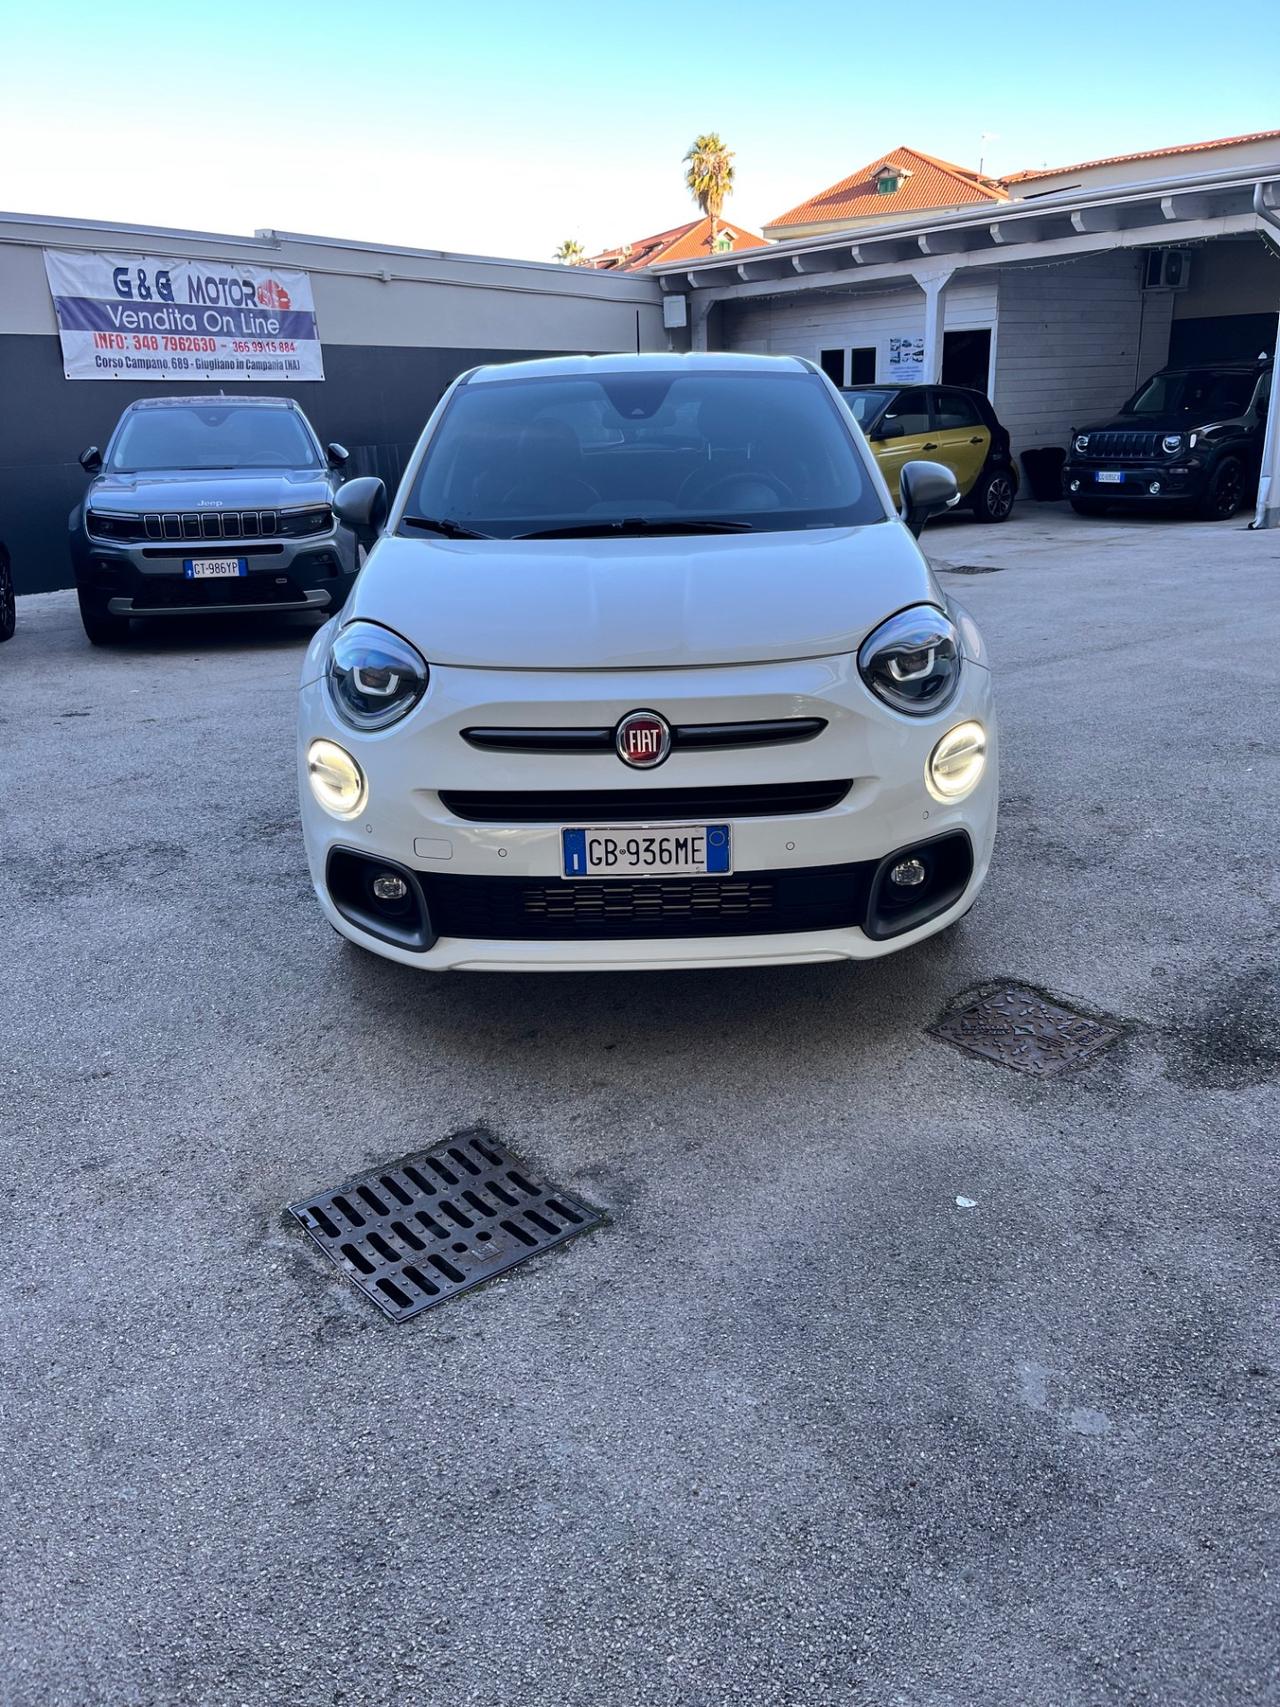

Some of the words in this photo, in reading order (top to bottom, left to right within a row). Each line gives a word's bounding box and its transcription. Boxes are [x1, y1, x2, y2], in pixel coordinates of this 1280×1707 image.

[187, 274, 258, 307] MOTOR
[106, 304, 197, 332] Vendita
[203, 310, 235, 333] On
[240, 312, 280, 335] Line
[93, 332, 129, 350] INFO:
[132, 334, 159, 351] 348
[161, 335, 217, 353] 7962630
[95, 355, 124, 369] Corso
[171, 357, 190, 370] 689
[195, 358, 235, 372] Giugliano
[236, 359, 245, 370] in
[245, 359, 284, 372] Campania
[197, 500, 223, 508] Jeep
[629, 729, 659, 753] FIAT
